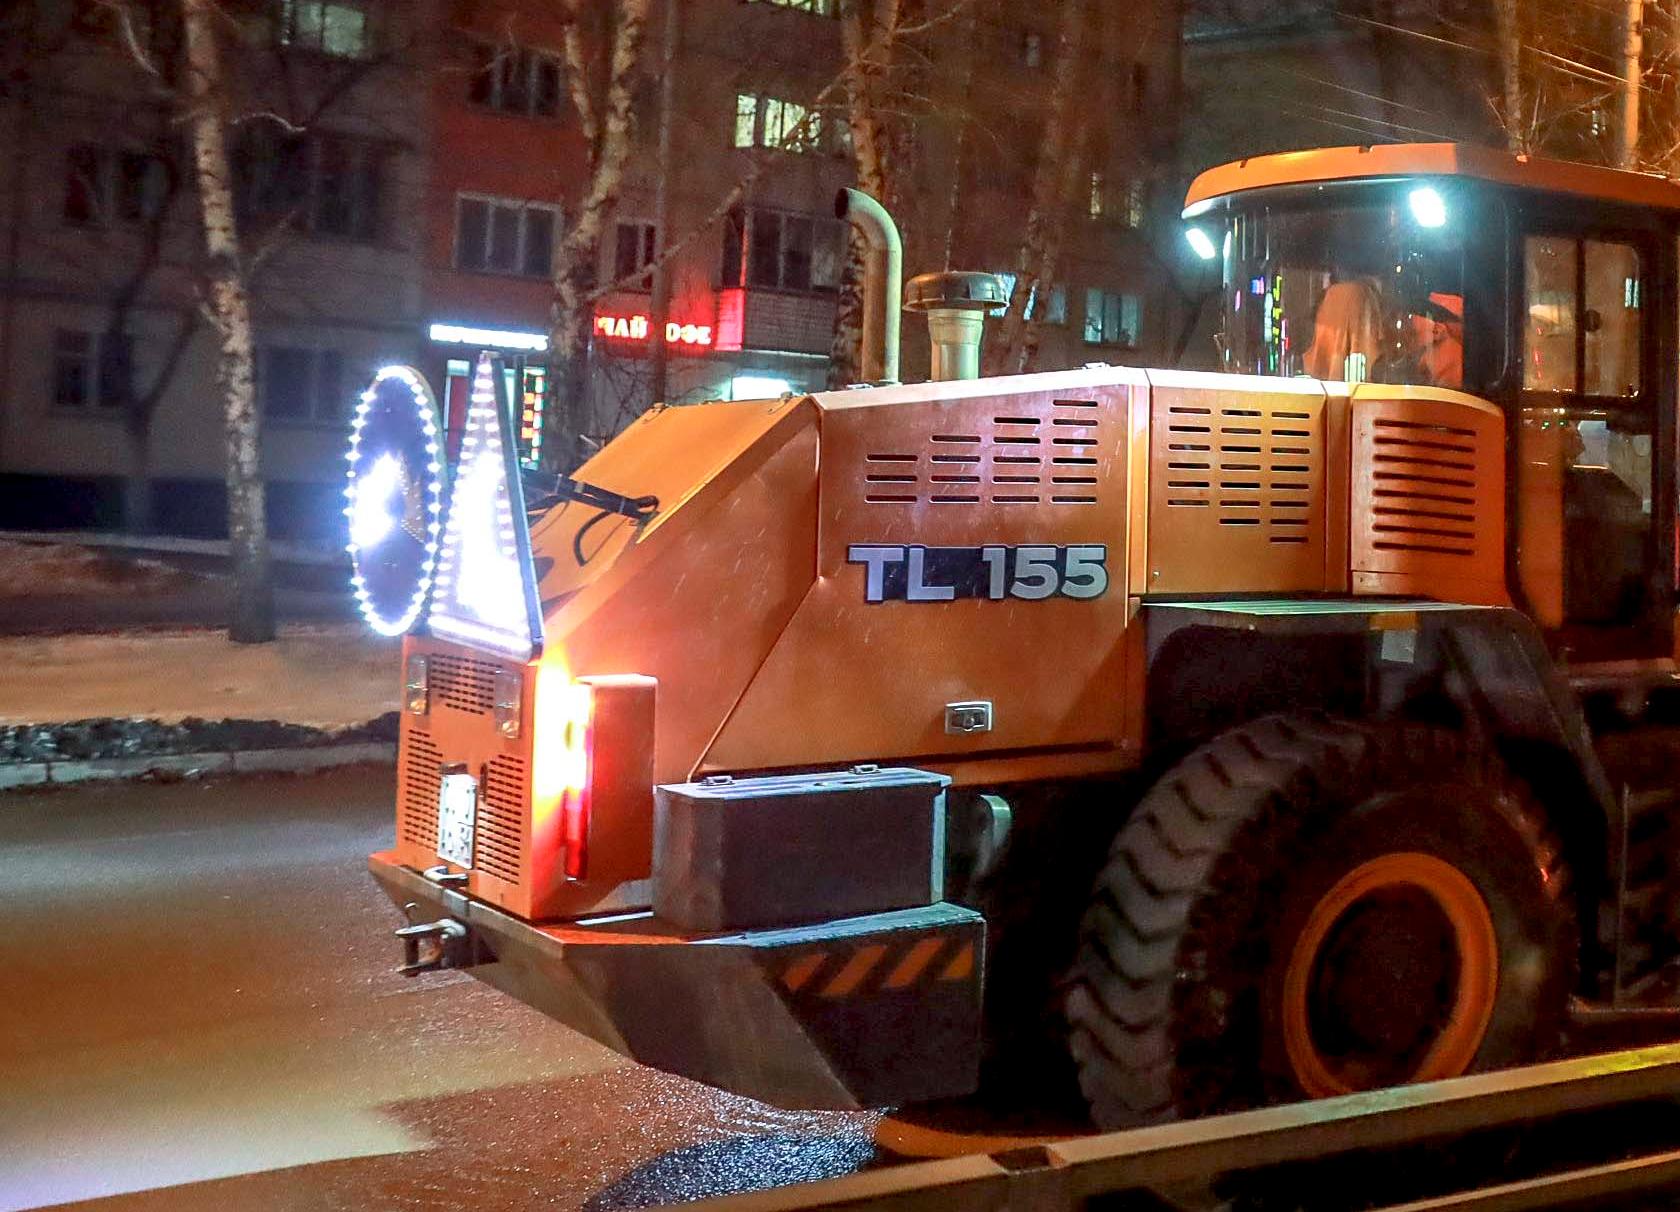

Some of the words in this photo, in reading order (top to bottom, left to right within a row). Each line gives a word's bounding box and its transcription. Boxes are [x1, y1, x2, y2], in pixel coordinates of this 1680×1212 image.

[665, 322, 712, 345] ОФЕ
[847, 545, 955, 602] TL
[981, 545, 1108, 601] 155
